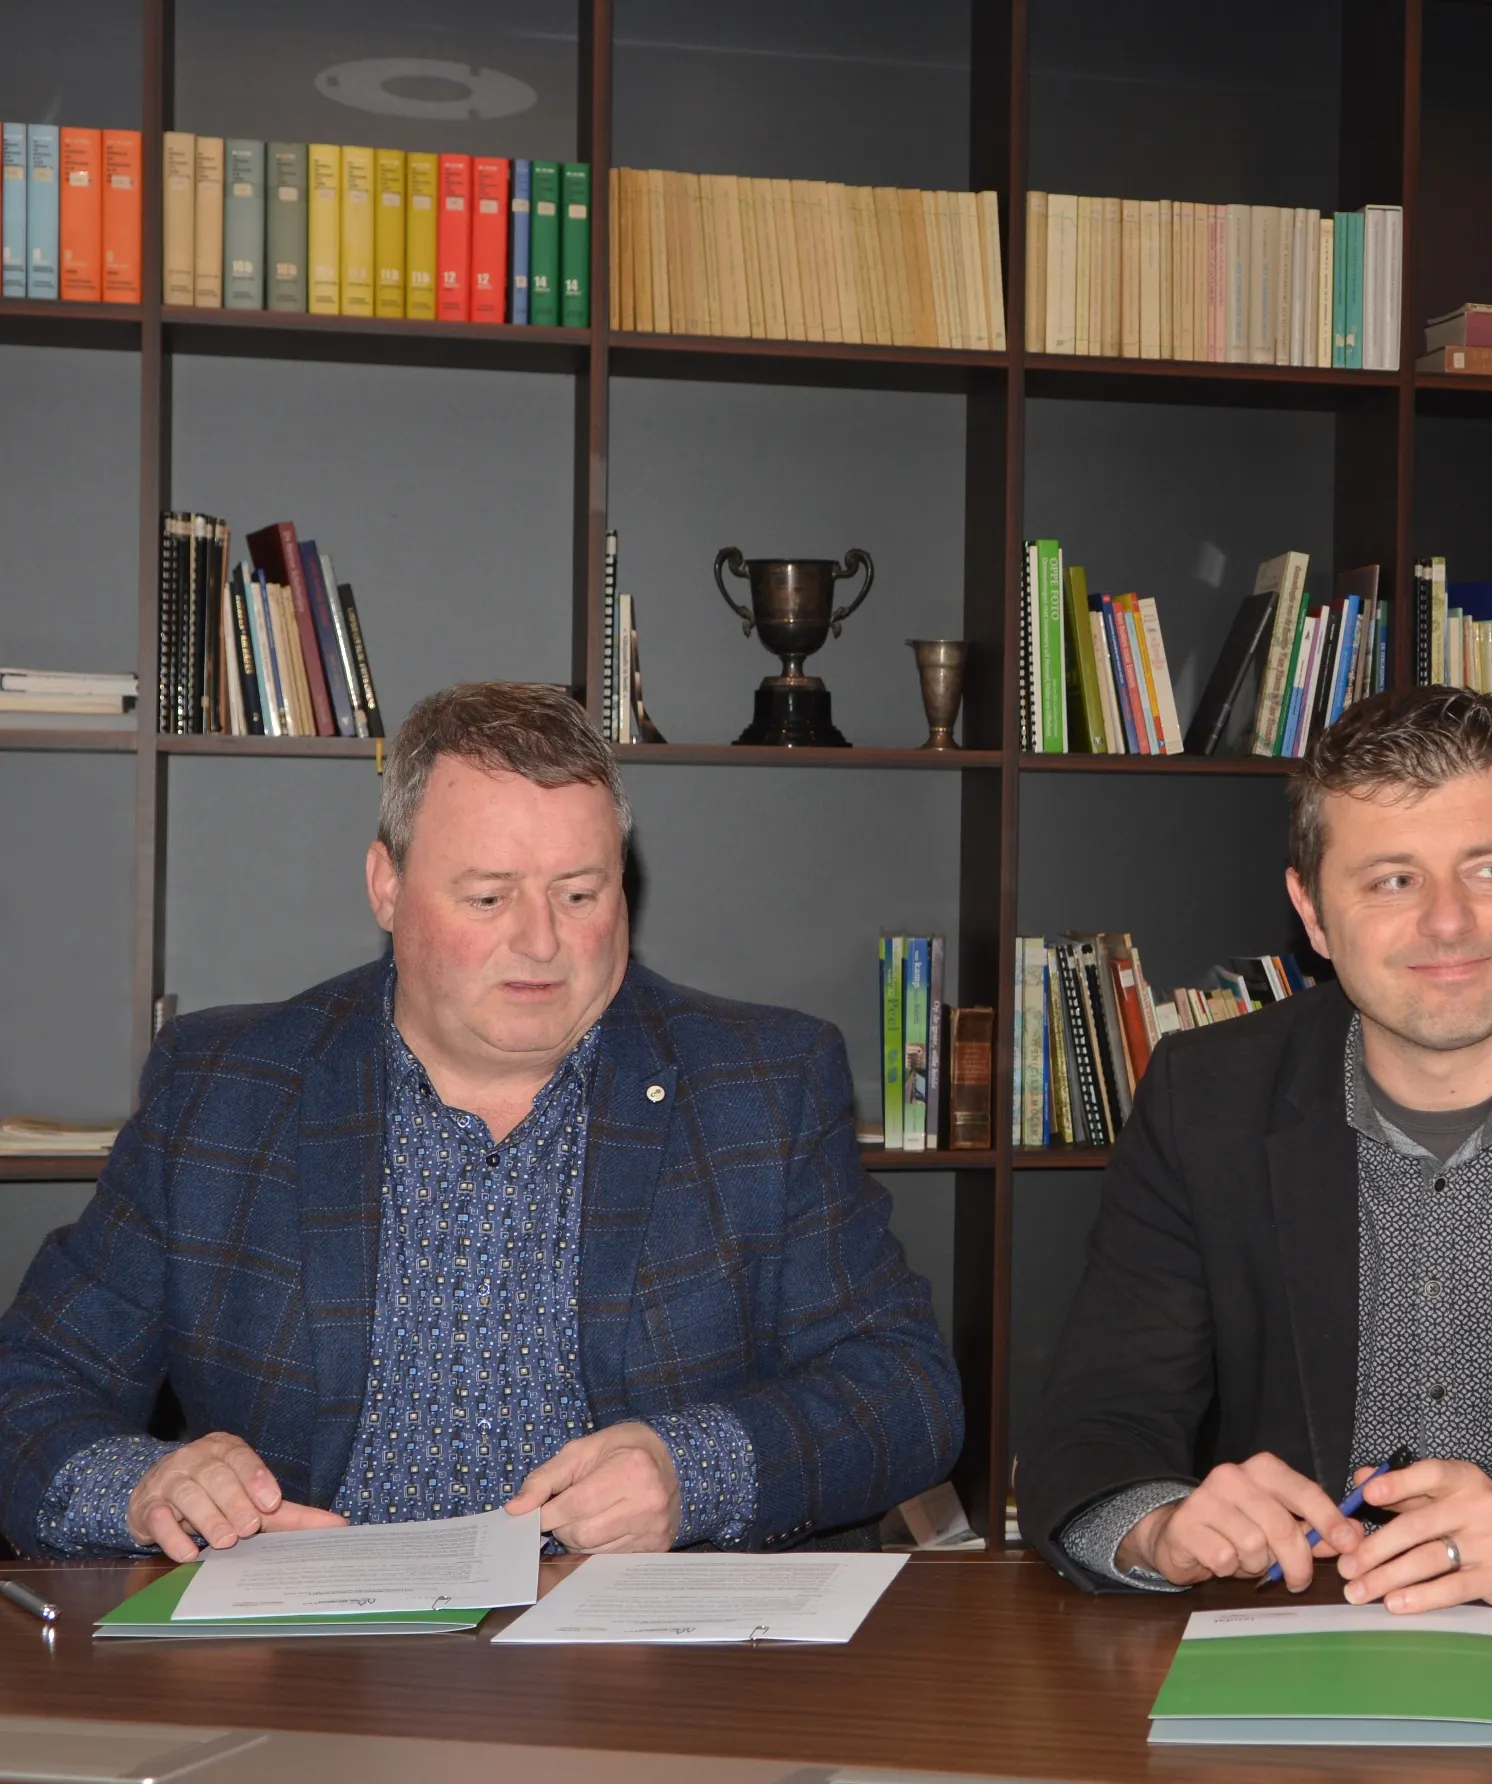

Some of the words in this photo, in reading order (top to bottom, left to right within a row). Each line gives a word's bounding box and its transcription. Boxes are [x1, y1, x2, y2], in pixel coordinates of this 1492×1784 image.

[443, 270, 456, 283] 12
[476, 272, 491, 285] 12
[534, 275, 548, 288] 14
[565, 278, 579, 291] 14
[1049, 557, 1059, 586] OPPE
[1050, 589, 1060, 621] FOTO
[912, 961, 921, 988] kamp
[932, 1000, 940, 1013] Op
[887, 998, 900, 1031] Peel
[932, 1014, 940, 1024] de
